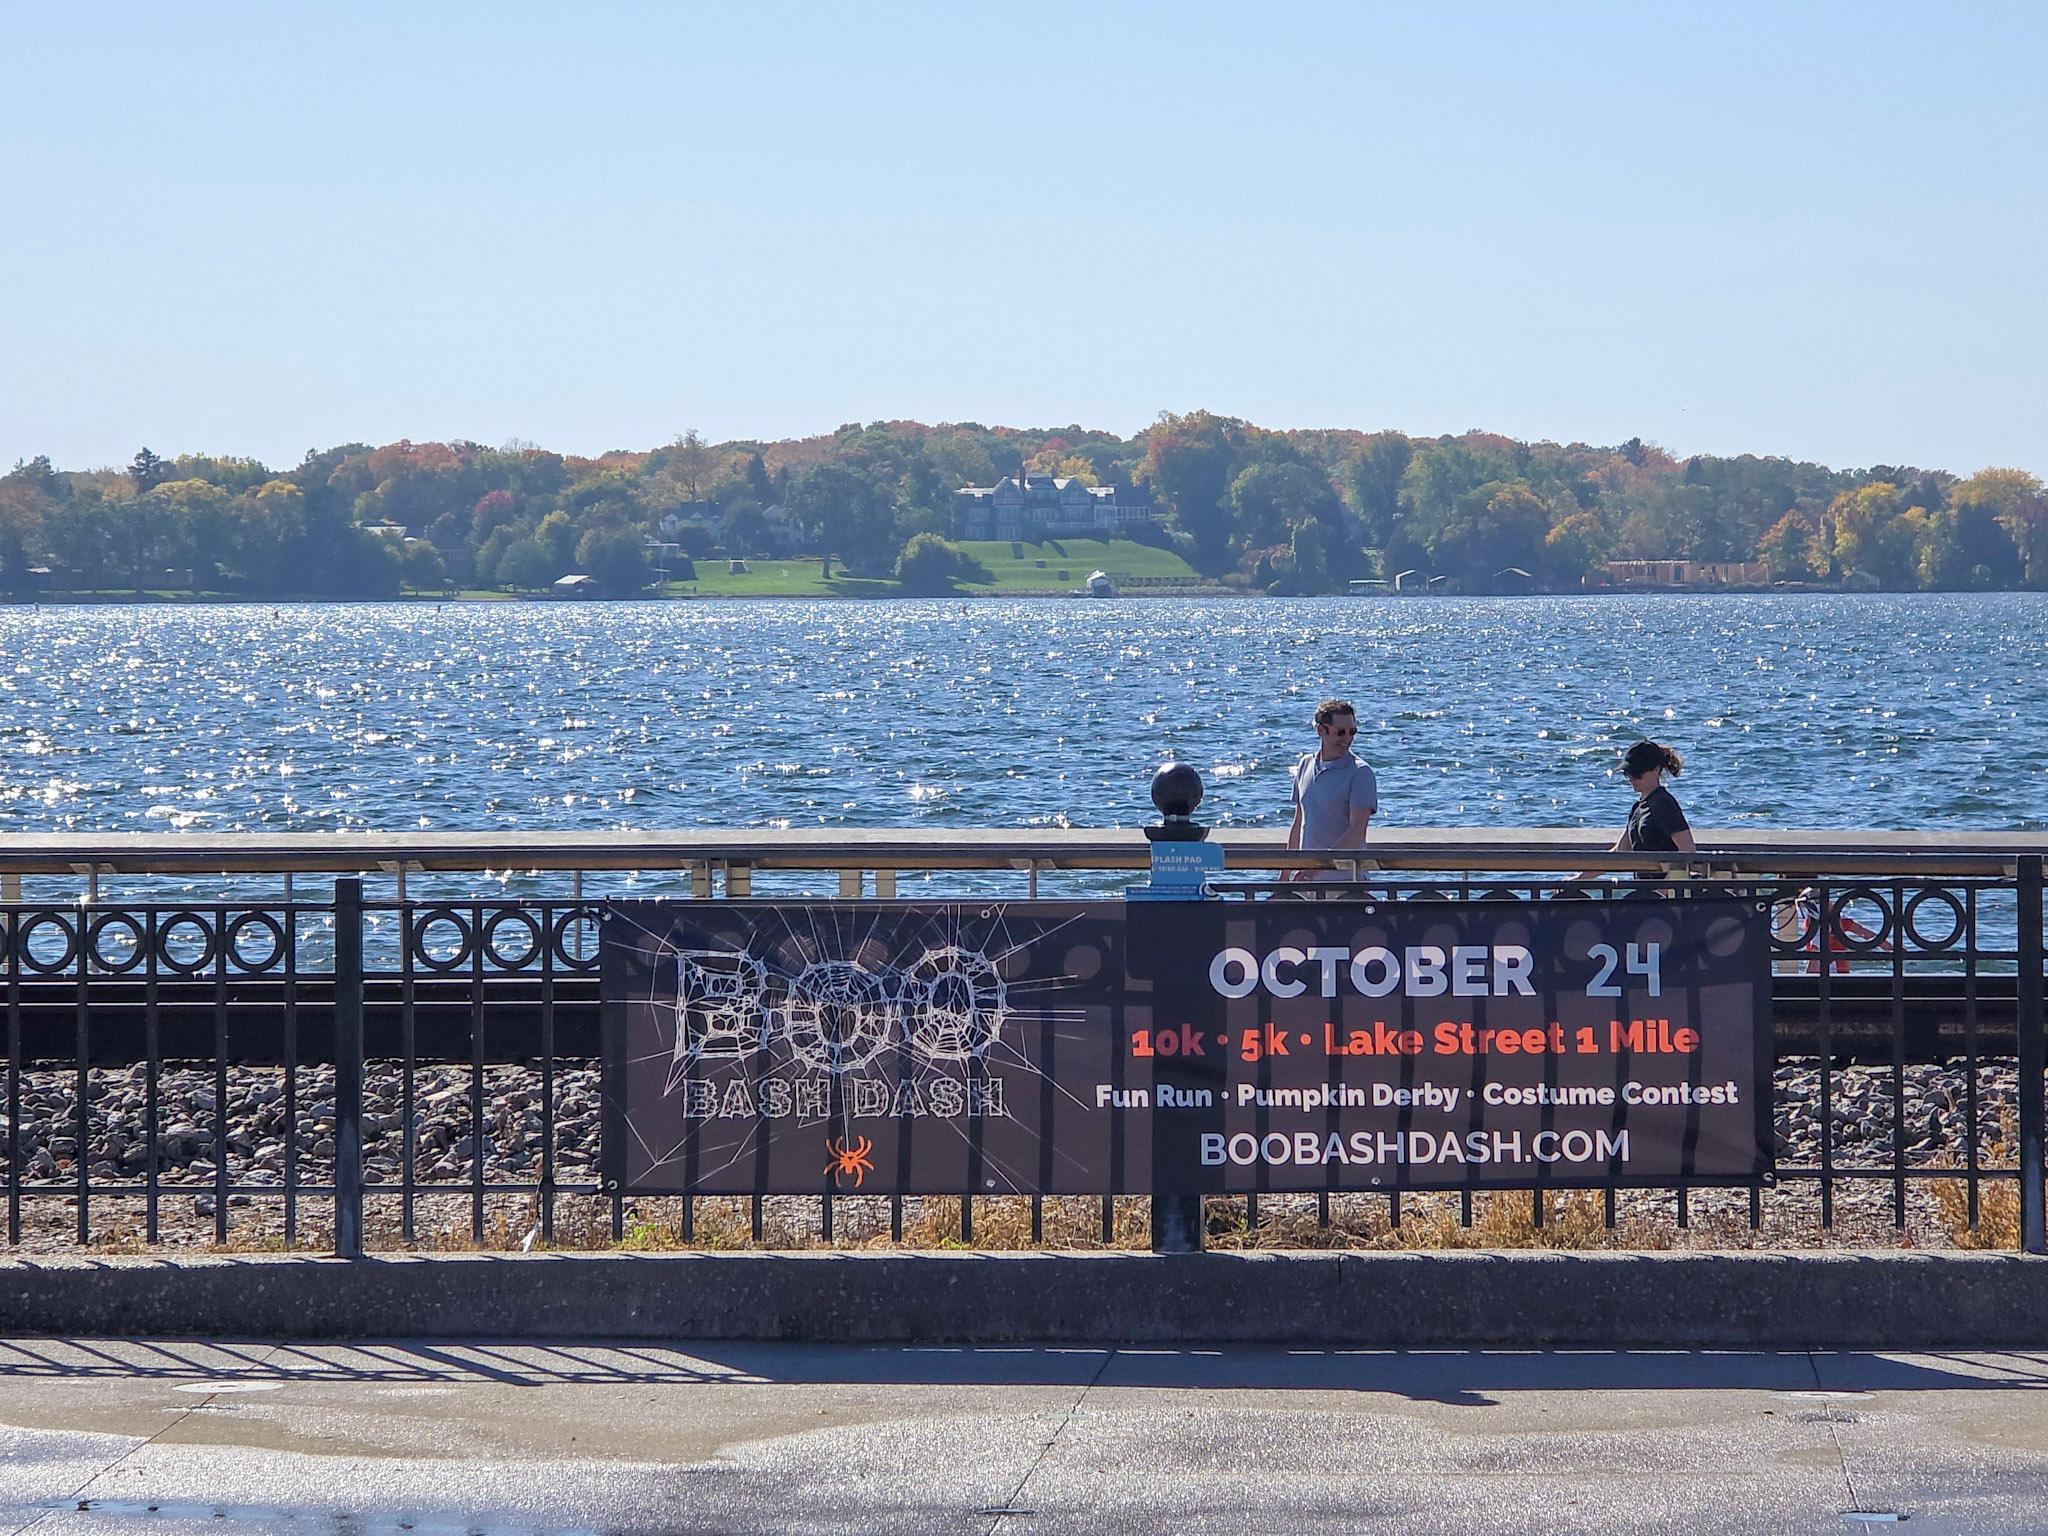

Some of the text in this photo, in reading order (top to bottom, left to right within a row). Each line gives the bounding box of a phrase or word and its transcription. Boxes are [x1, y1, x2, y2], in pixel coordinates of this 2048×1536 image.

[1184, 855, 1202, 864] PAD
[1208, 942, 1661, 999] OCTOBER 24
[674, 947, 1006, 1073] BOO
[1131, 1019, 1700, 1062] 10k 5k Lake Street 1 Mile
[682, 1077, 1003, 1119] BASH DASH
[1095, 1080, 1739, 1112] Fun Run Pumpkin Derby Costume Contest
[1200, 1129, 1631, 1166] BOOBASHDASH.COM
